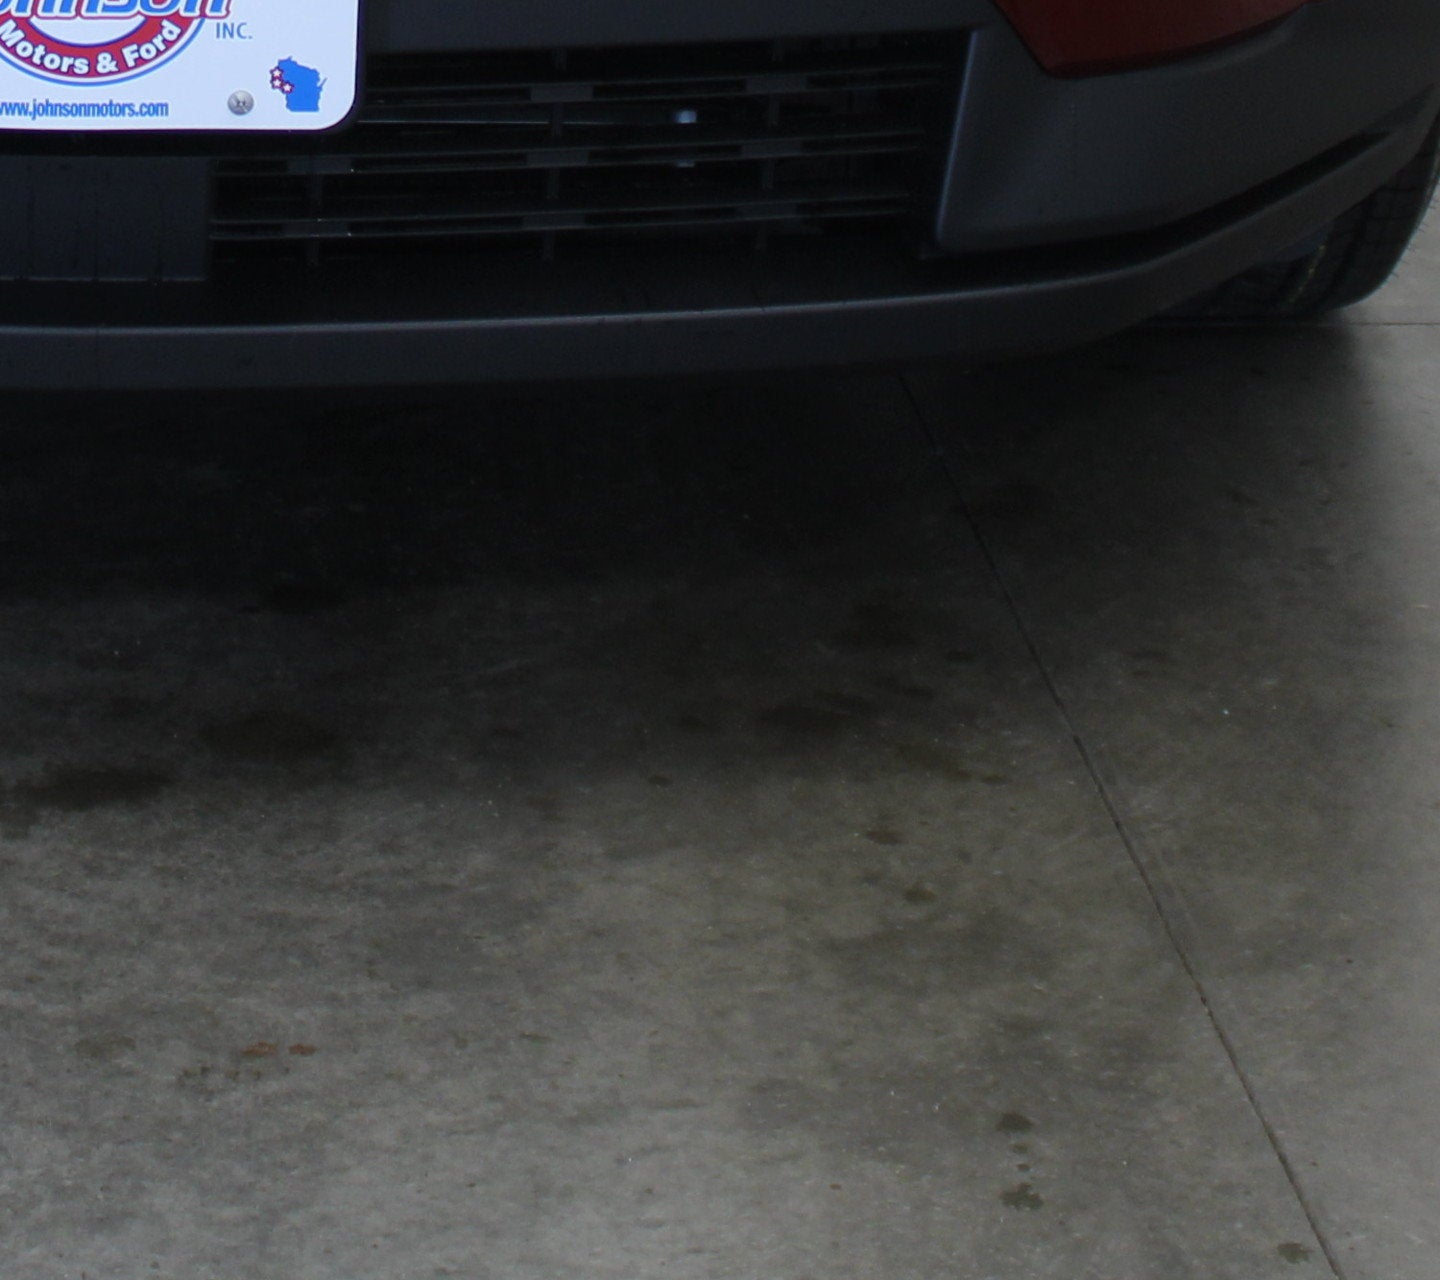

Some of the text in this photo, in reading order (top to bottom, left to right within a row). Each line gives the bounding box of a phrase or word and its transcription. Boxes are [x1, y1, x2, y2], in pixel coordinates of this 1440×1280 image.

[96, 51, 120, 74] &
[122, 19, 183, 68] Ford
[215, 21, 254, 40] INC.
